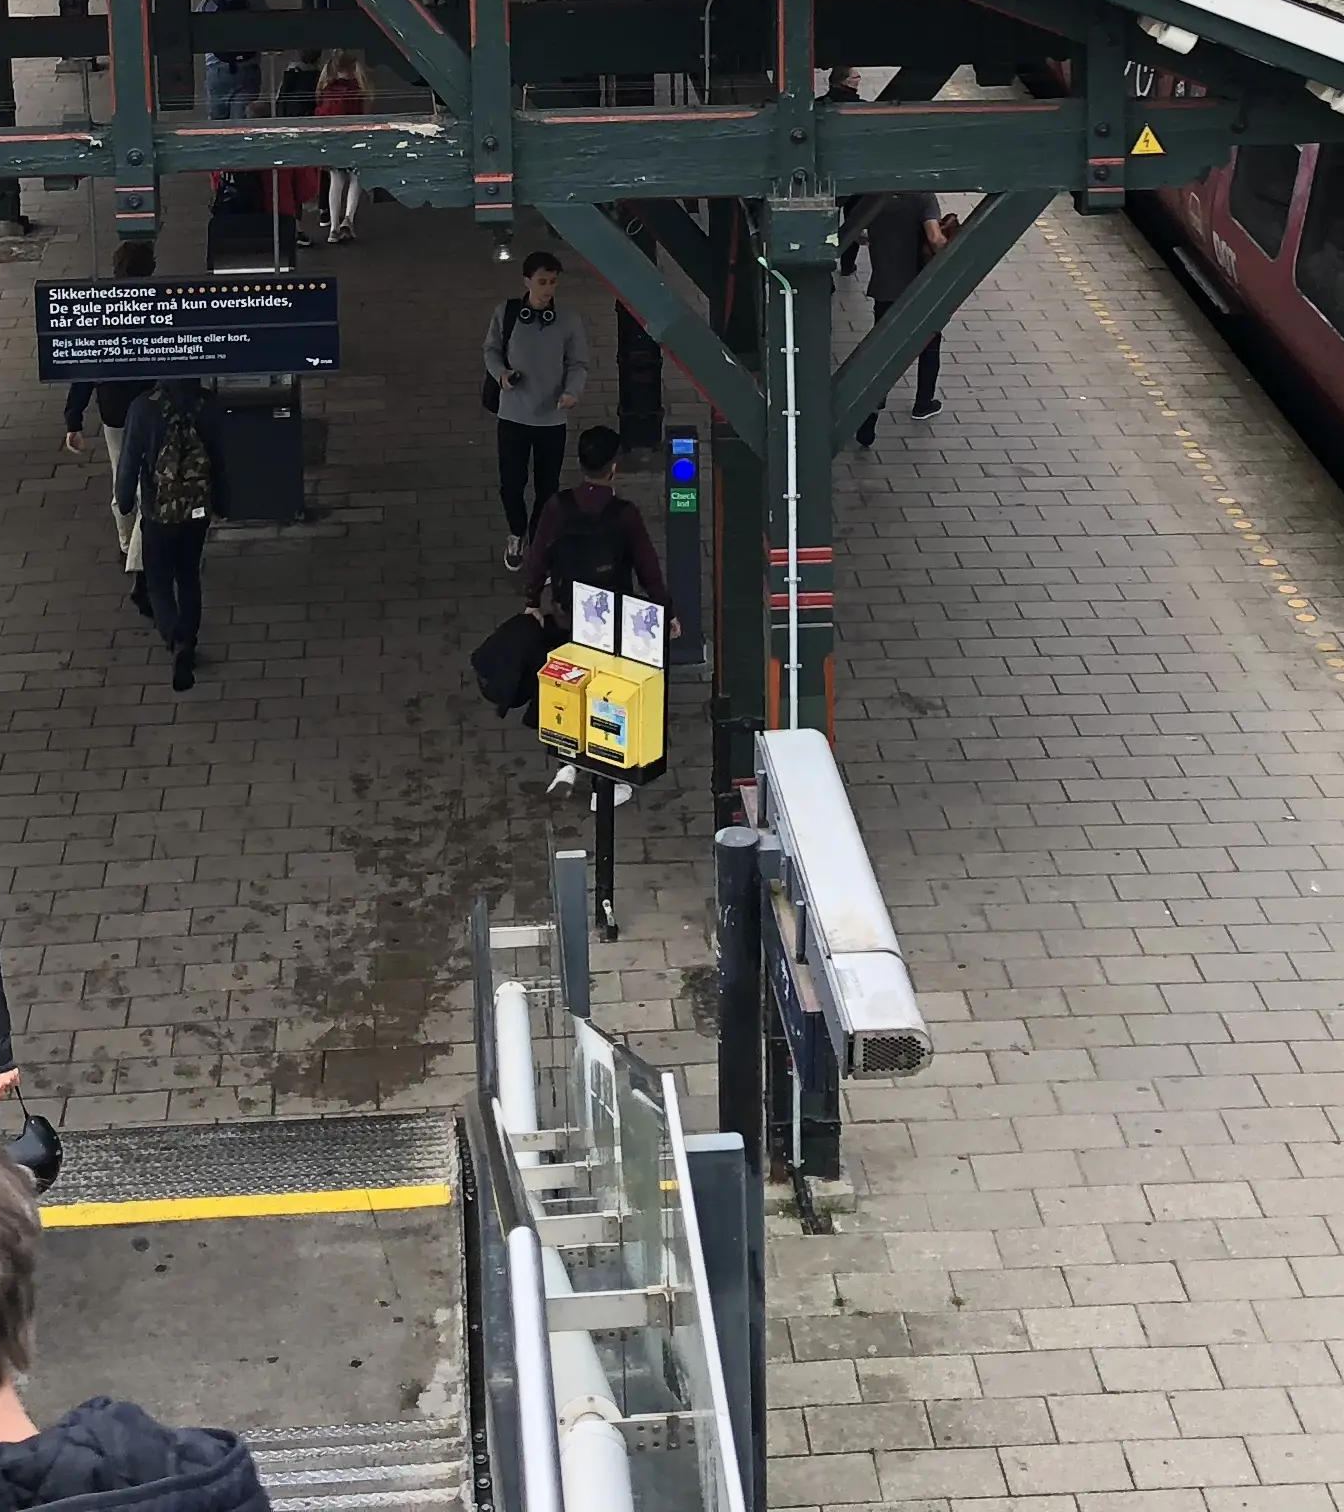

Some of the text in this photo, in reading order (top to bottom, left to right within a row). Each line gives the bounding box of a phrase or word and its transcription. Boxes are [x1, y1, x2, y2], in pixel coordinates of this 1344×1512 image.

[49, 287, 157, 301] Sikkerhedszone
[49, 294, 293, 316] De gule prikker må kun overskrides,
[50, 314, 174, 328] når der holder tog
[52, 333, 251, 349] Rejs ikke med S-tog uden billet eller kort,
[52, 348, 69, 358] det
[71, 348, 102, 357] koster
[102, 346, 121, 356] 750
[123, 346, 136, 356] kr.
[143, 344, 204, 355] kontrolafgift
[671, 492, 697, 500] Check
